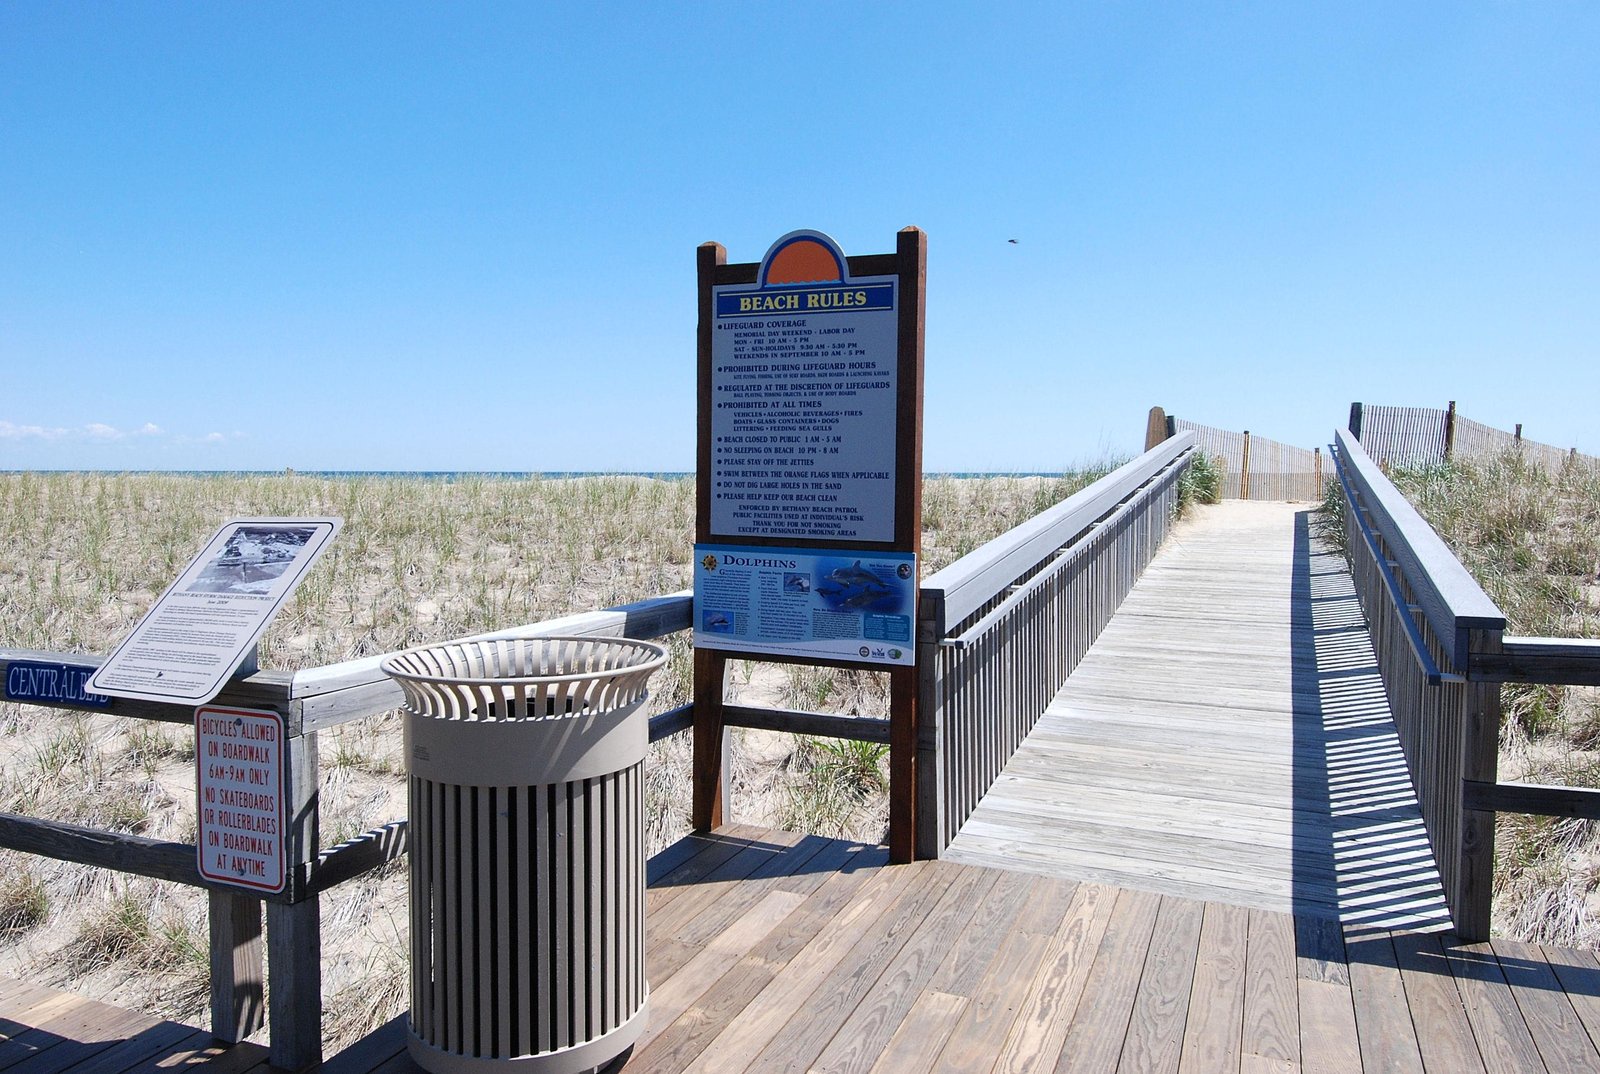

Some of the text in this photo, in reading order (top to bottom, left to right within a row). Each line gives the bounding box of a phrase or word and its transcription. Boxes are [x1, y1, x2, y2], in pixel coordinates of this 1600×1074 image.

[740, 291, 867, 311] BEACH RULES
[723, 319, 806, 330] LIFEGUARD COVERAGE
[723, 361, 876, 372] PROHIBITED DURING LIFEGUARD HOURS
[790, 382, 832, 390] DISCRETION
[833, 382, 844, 390] OF
[845, 381, 890, 389] LIFEGUARDS
[796, 400, 822, 408] TIMES
[773, 446, 794, 454] BEACH
[798, 446, 805, 454] 10
[807, 446, 816, 454] PM
[775, 458, 788, 466] THE
[789, 458, 814, 466] JETTIES
[770, 470, 782, 478] THE
[783, 470, 808, 478] ORANGE
[851, 471, 889, 479] APPLICABLE
[759, 481, 778, 489] LARGE
[824, 482, 841, 490] SAND
[723, 492, 744, 500] PLEASE
[817, 494, 837, 502] CLEAN
[807, 528, 835, 536] SMOKING
[723, 555, 797, 569] DOLPHINS
[9, 666, 77, 699] CENTRAL
[202, 718, 275, 742] BICYCLES ALLOWED
[208, 741, 270, 764] ON BOARDWALK
[209, 764, 270, 786] 6AM-9AM ONLY
[205, 787, 274, 812] NO SKATEBOARDS
[204, 808, 276, 835] OR ROLLERBLADES
[209, 830, 273, 856] ON BOARDWALK
[217, 854, 266, 877] AT ANYTIME
